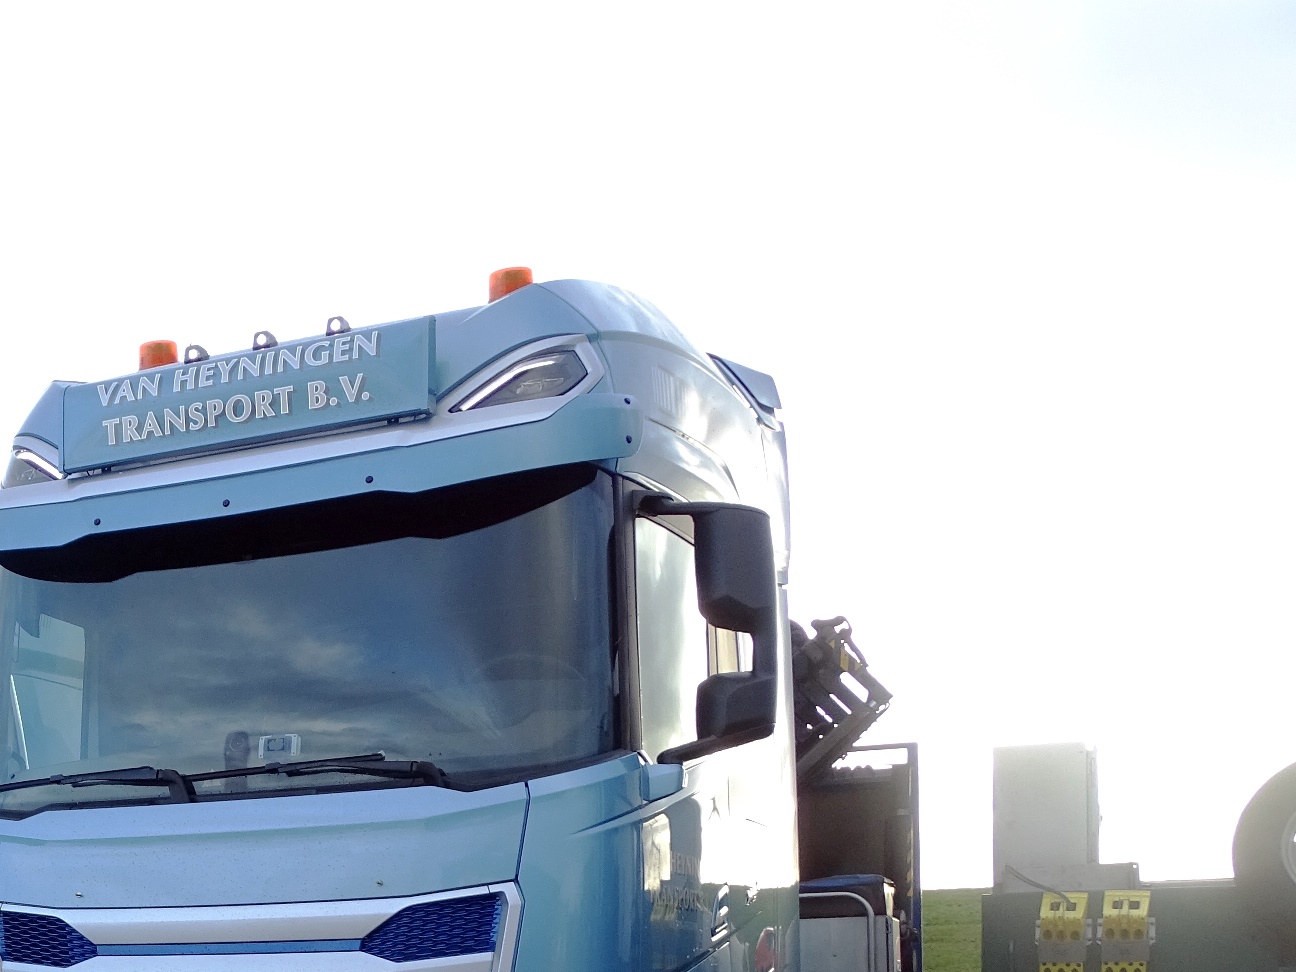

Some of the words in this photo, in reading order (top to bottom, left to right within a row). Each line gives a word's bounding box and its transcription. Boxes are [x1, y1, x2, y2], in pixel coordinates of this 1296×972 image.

[96, 372, 163, 407] VAN
[172, 330, 382, 393] HEYNINGEN
[102, 381, 295, 446] TRANSPORT
[308, 372, 371, 412] B.V.
